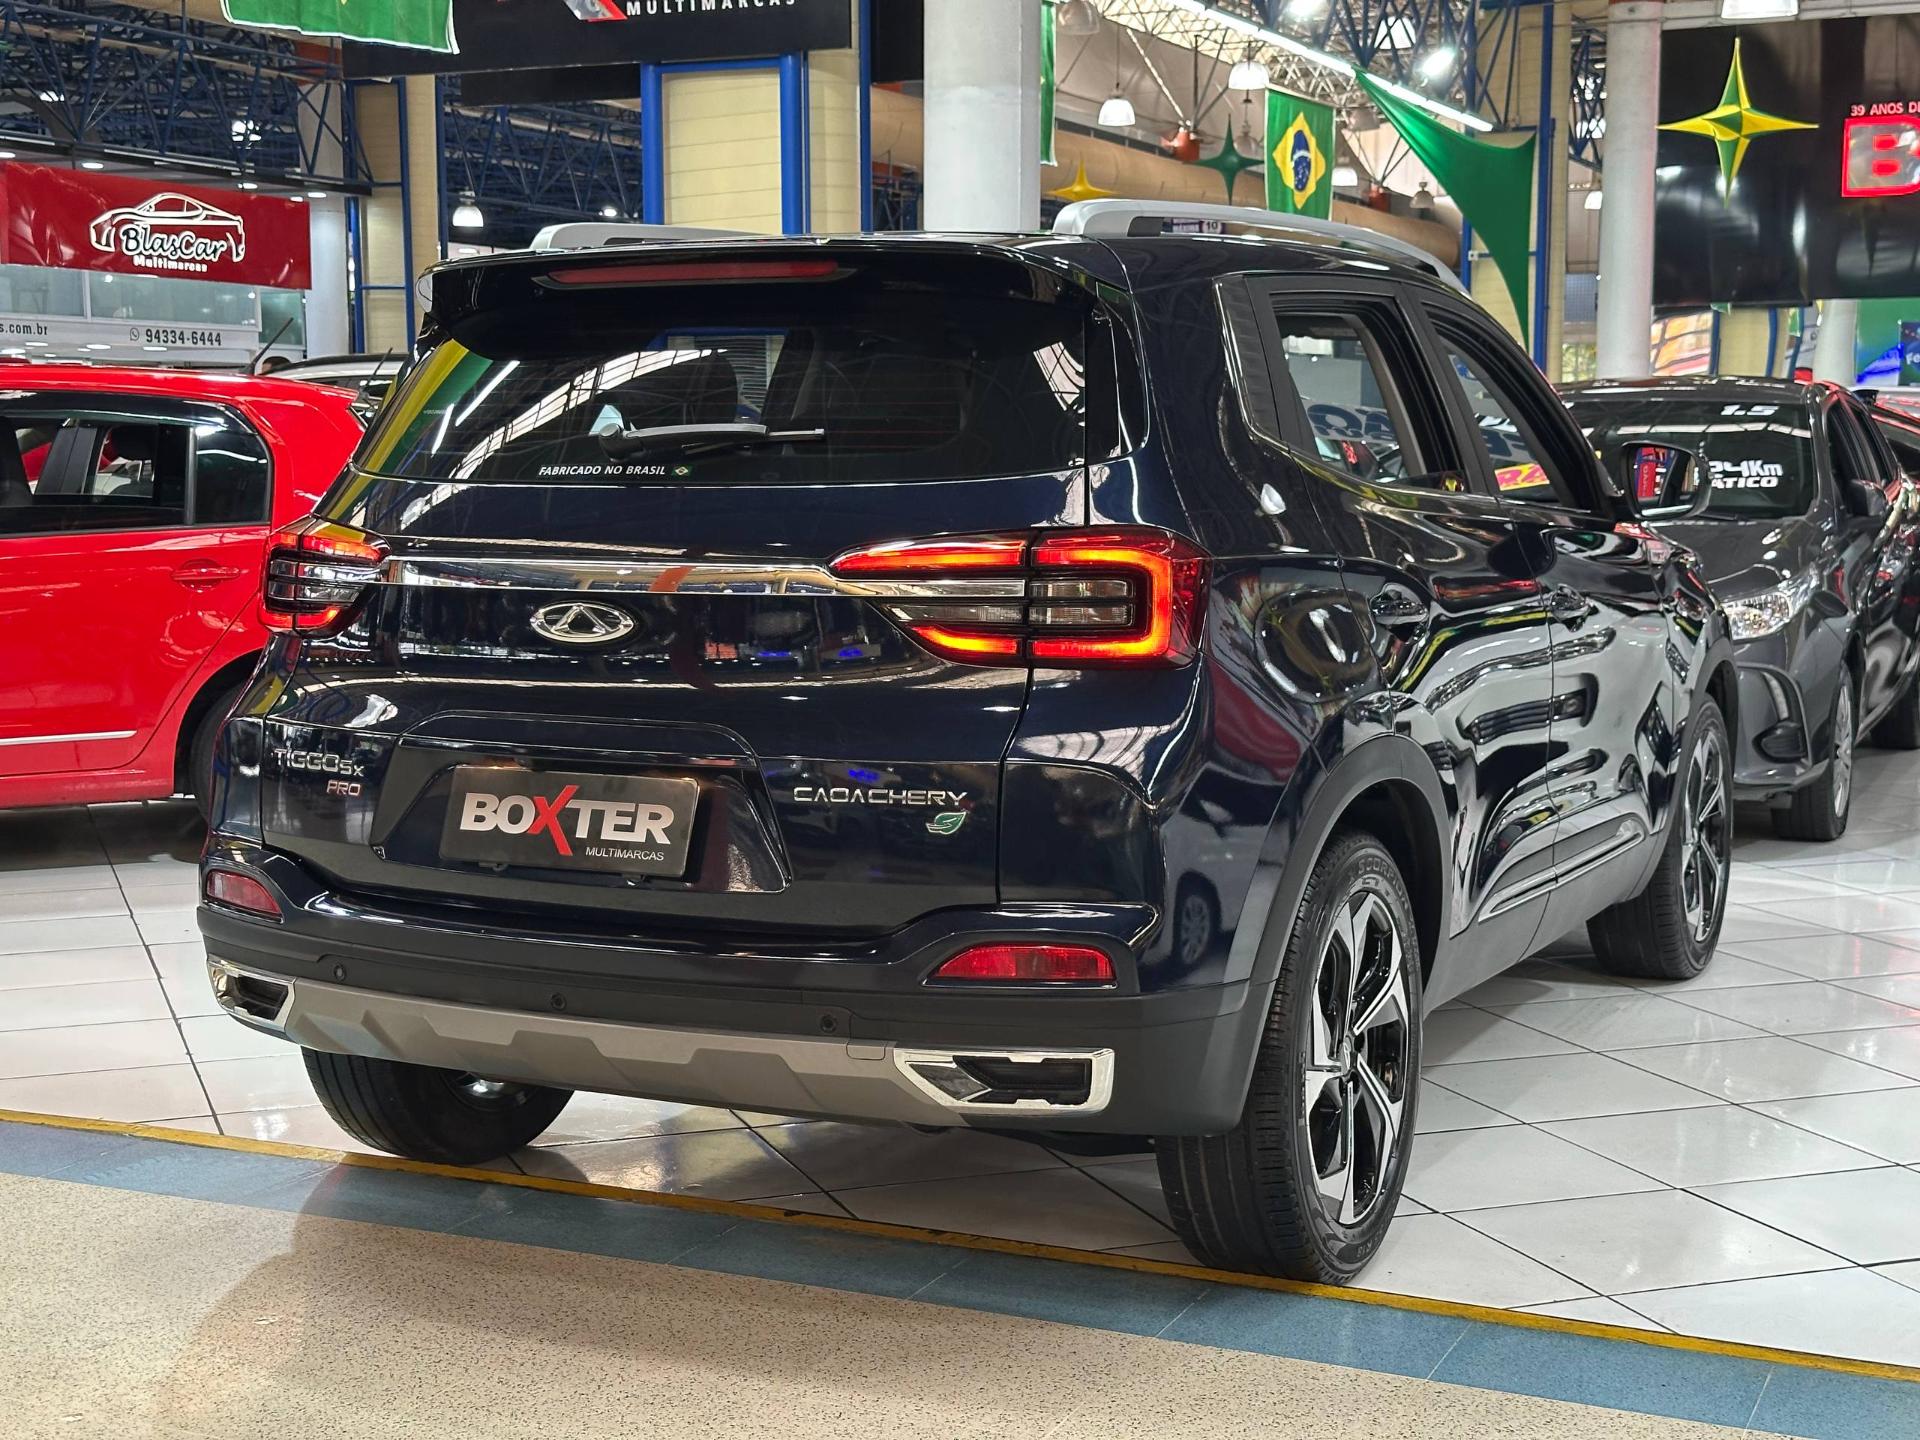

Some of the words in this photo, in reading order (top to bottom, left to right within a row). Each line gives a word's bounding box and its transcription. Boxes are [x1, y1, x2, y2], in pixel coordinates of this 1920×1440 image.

[1851, 105, 1866, 116] 39
[1870, 102, 1904, 115] ANOS
[1908, 101, 1920, 113] D
[120, 224, 228, 263] BlasCar
[133, 255, 208, 272] Multimarcas
[145, 328, 222, 346] 94334-6444
[1720, 404, 1780, 416] 1.5
[538, 465, 601, 476] FABRICADO
[604, 465, 623, 475] NO
[625, 465, 666, 475] BRASIL
[326, 780, 361, 796] PRO
[459, 784, 675, 857] BOXTER
[585, 846, 665, 861] MULTIMARCAS
